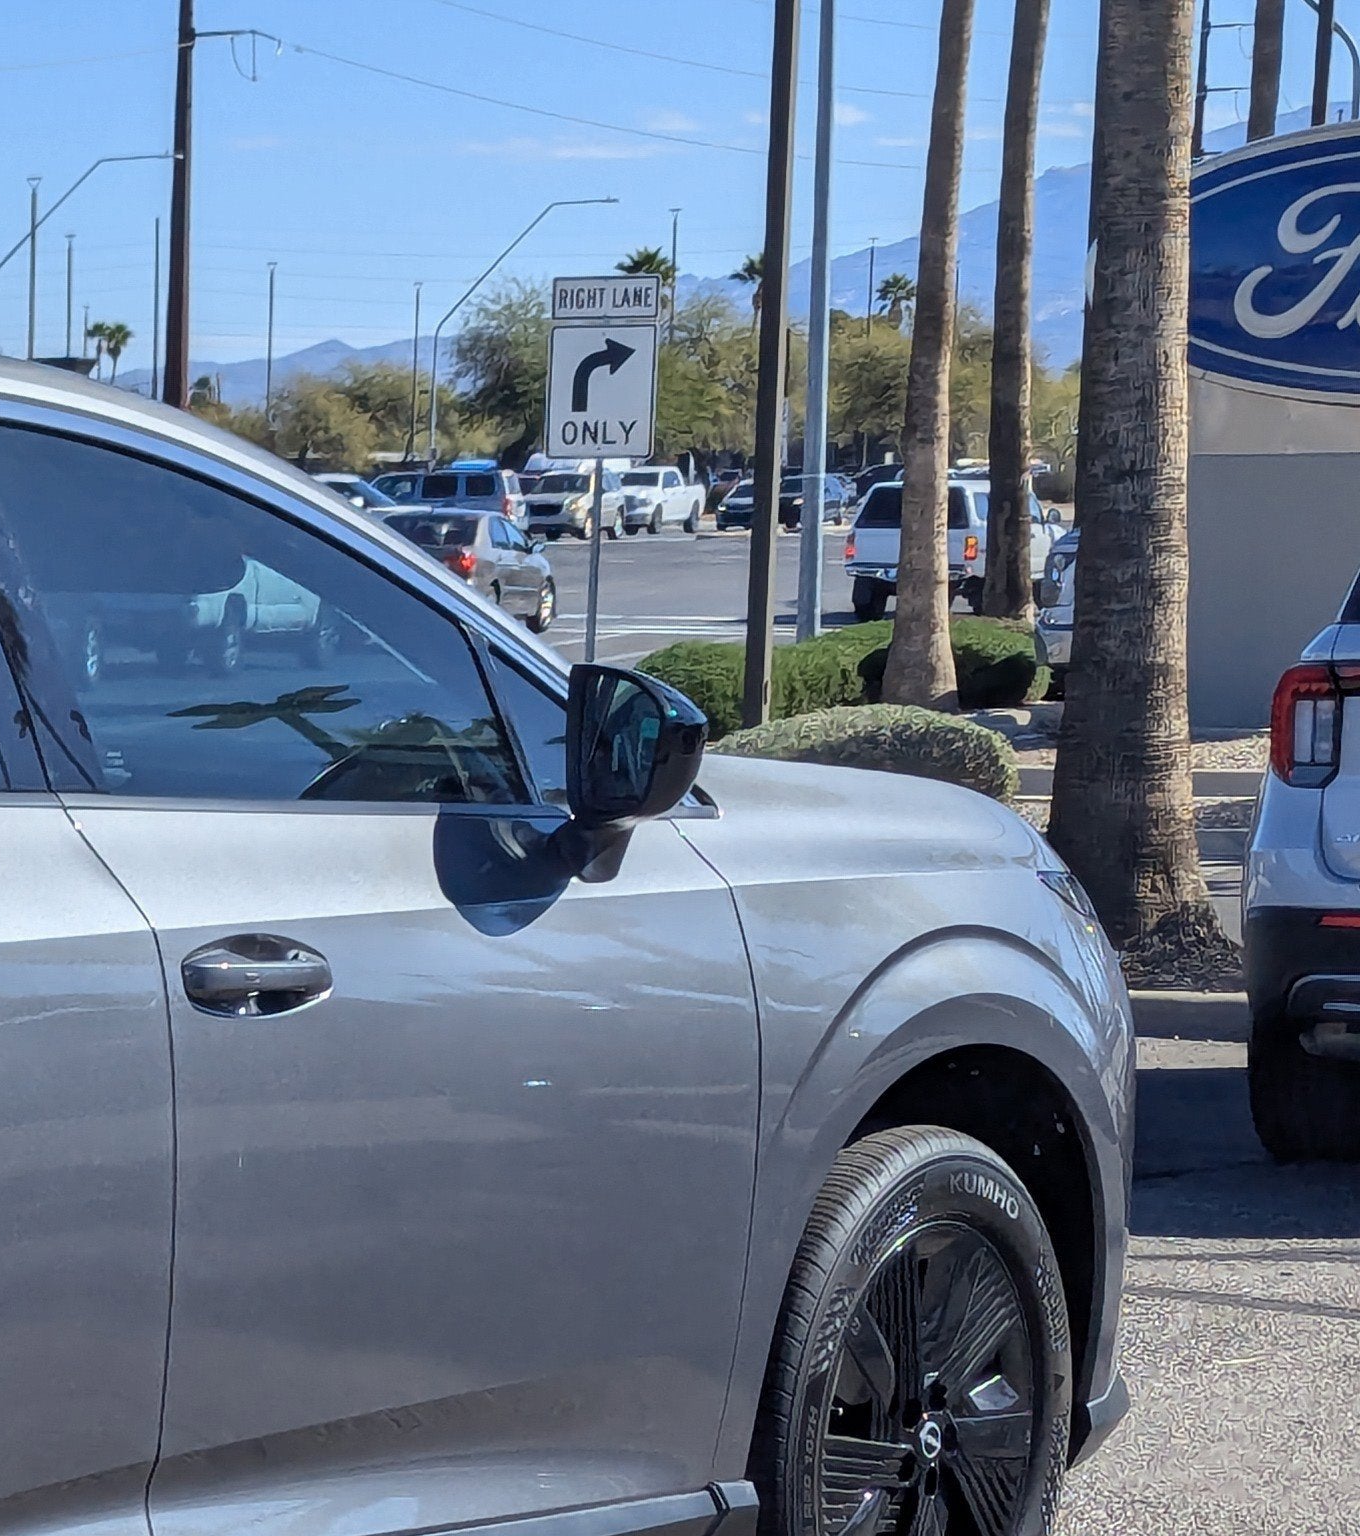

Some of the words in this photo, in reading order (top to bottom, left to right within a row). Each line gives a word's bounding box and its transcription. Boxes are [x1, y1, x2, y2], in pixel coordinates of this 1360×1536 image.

[557, 287, 606, 310] RIGHT
[612, 286, 653, 309] LANE
[561, 419, 638, 446] ONLY
[949, 1172, 1019, 1220] KUMHO
